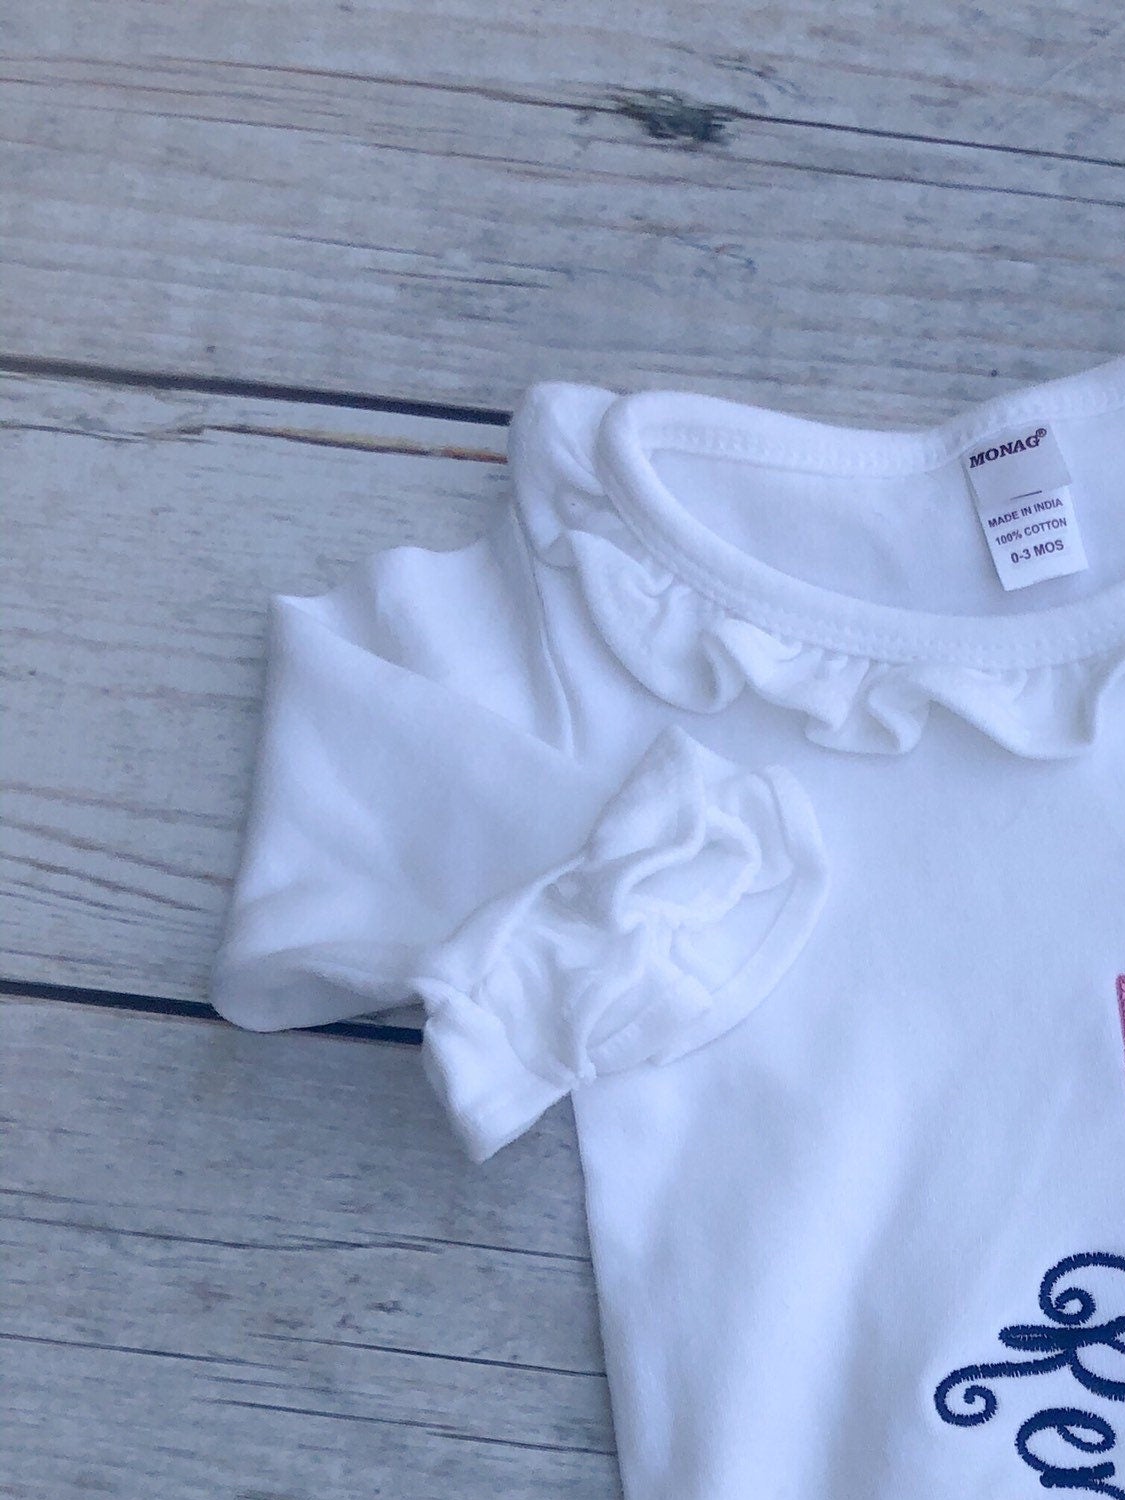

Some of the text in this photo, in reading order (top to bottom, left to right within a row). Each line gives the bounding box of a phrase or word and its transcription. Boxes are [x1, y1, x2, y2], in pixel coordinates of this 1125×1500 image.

[988, 498, 1064, 528] MADE IN INDIA
[995, 517, 1068, 546] 100% COTTON
[1010, 539, 1065, 564] 0-3 MOS
